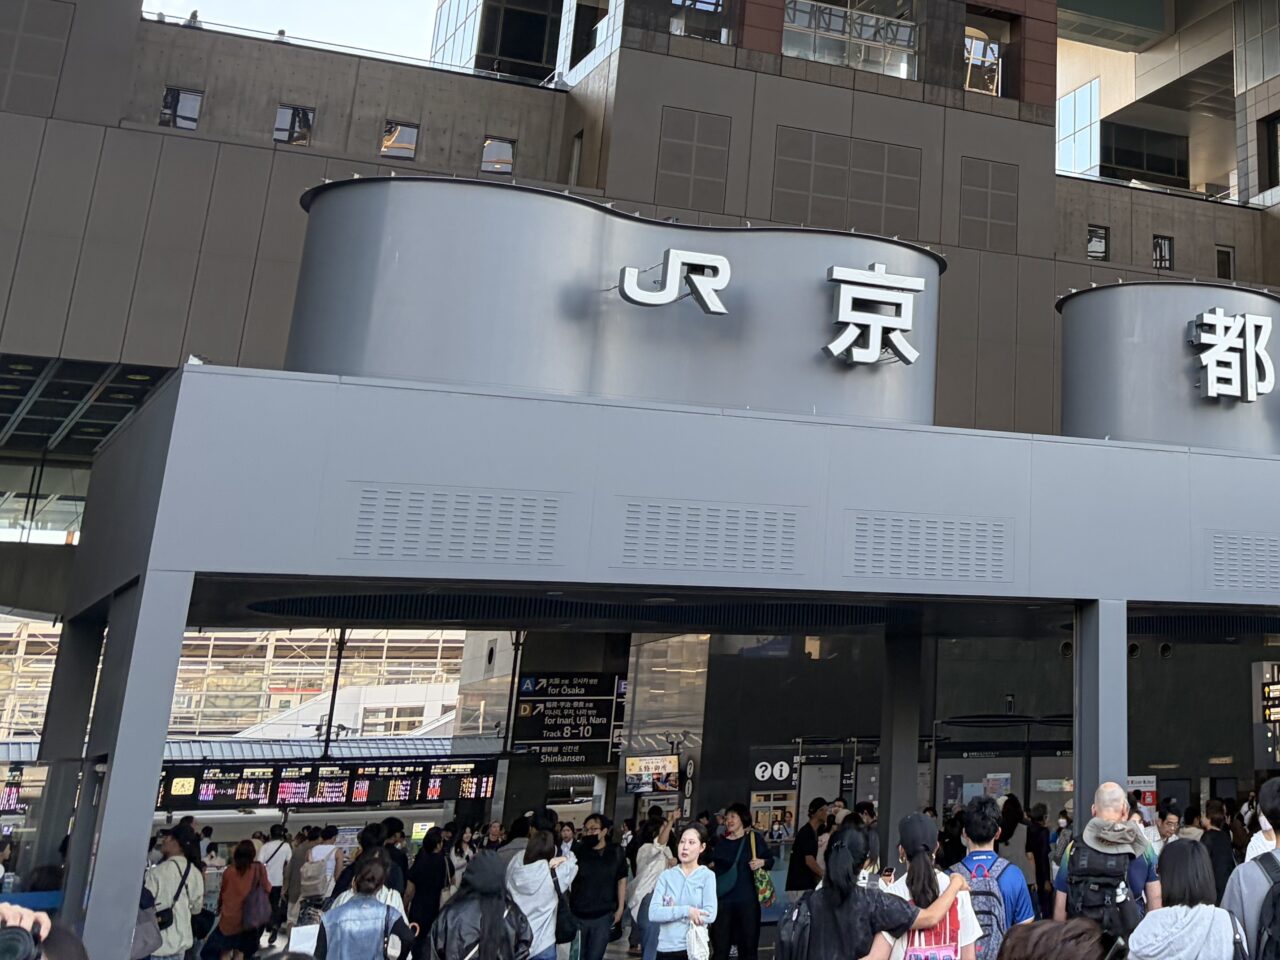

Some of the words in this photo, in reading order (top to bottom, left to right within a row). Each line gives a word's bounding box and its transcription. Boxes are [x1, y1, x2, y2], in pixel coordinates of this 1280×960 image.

[619, 248, 731, 315] JR
[822, 262, 925, 365] 京
[1198, 307, 1275, 402] 都
[522, 679, 533, 691] A
[548, 686, 559, 694] for
[520, 704, 530, 715] D
[544, 717, 556, 725] for
[556, 716, 575, 726] Inari,
[576, 716, 588, 726] Uji,
[589, 716, 607, 724] Nara
[540, 754, 586, 763] Shinkansen
